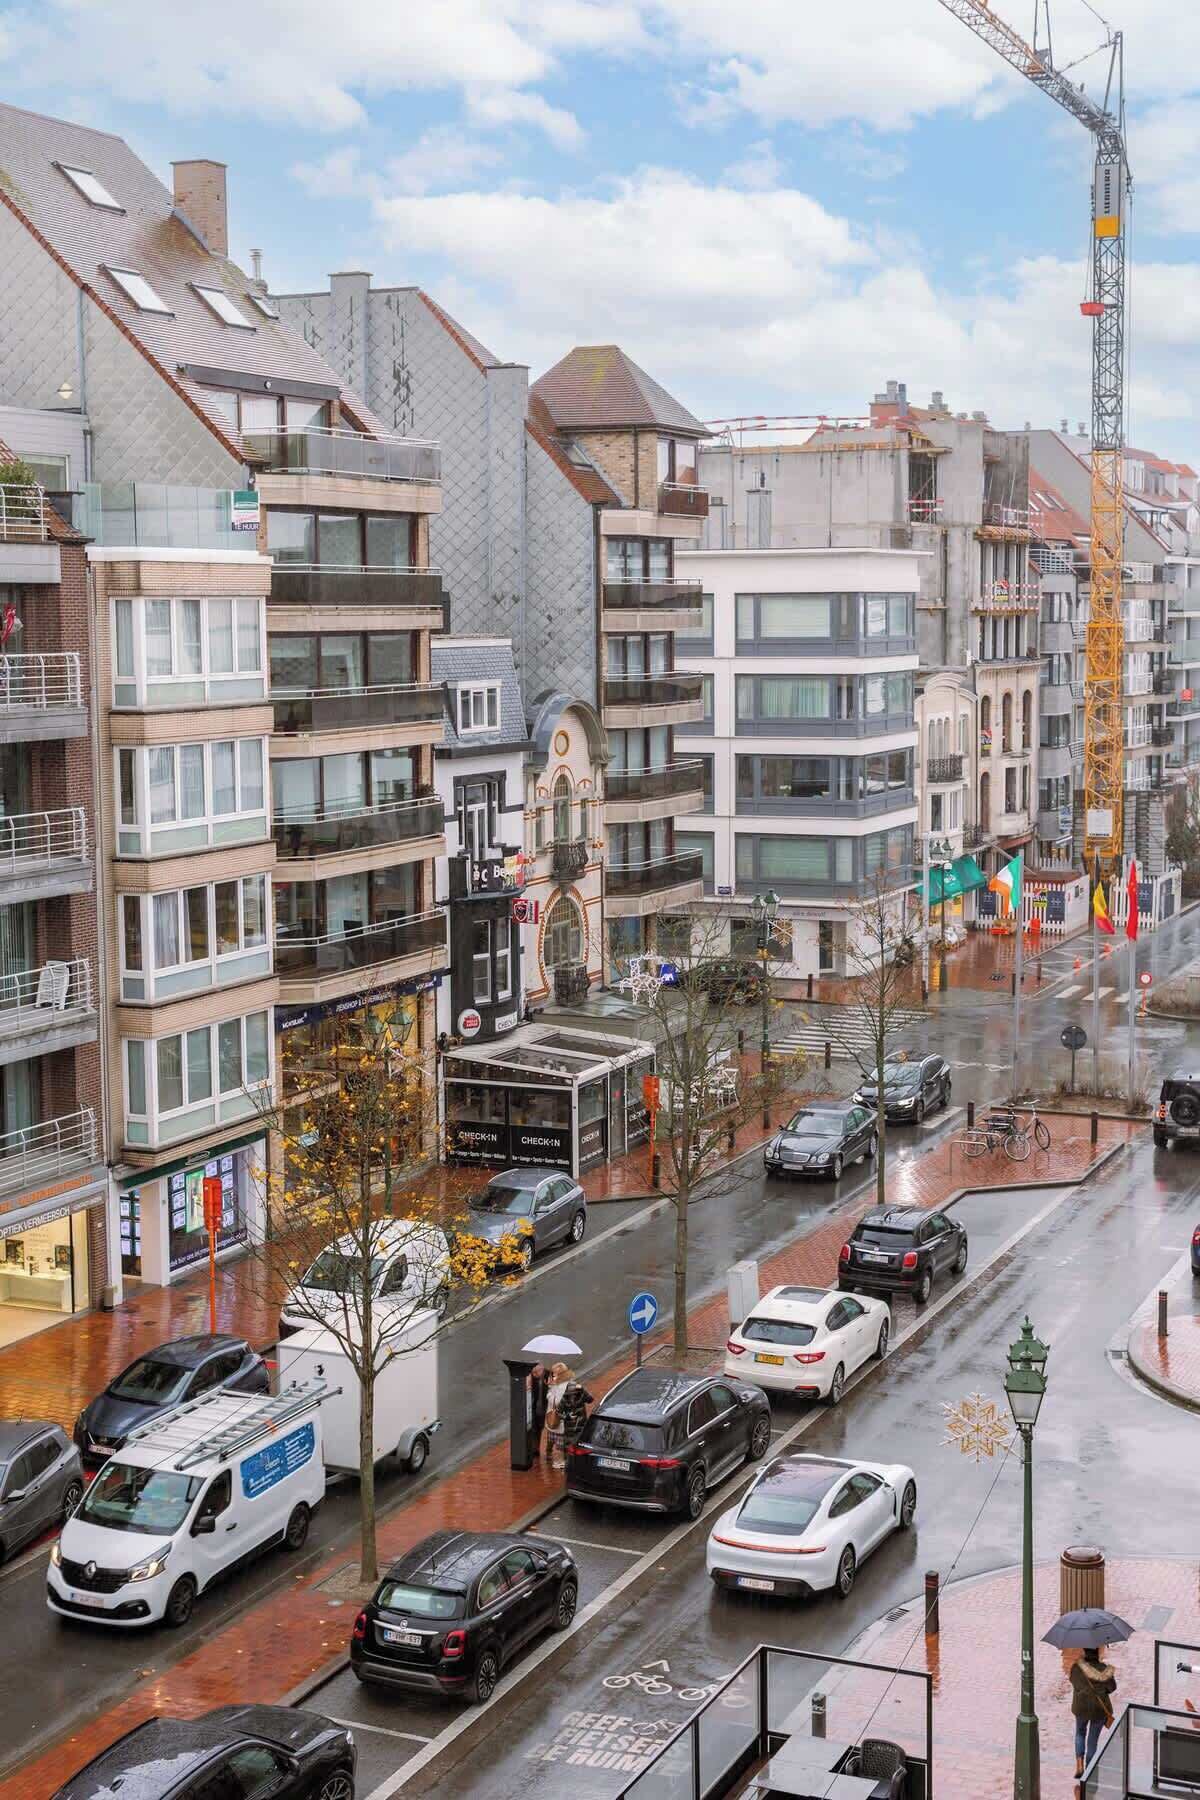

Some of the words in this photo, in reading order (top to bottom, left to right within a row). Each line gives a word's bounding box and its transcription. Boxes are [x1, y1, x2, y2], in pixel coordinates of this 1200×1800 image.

[521, 1136, 561, 1147] CHECK-IN
[560, 1711, 633, 1731] GEEF
[552, 1727, 667, 1757] FIETSER
